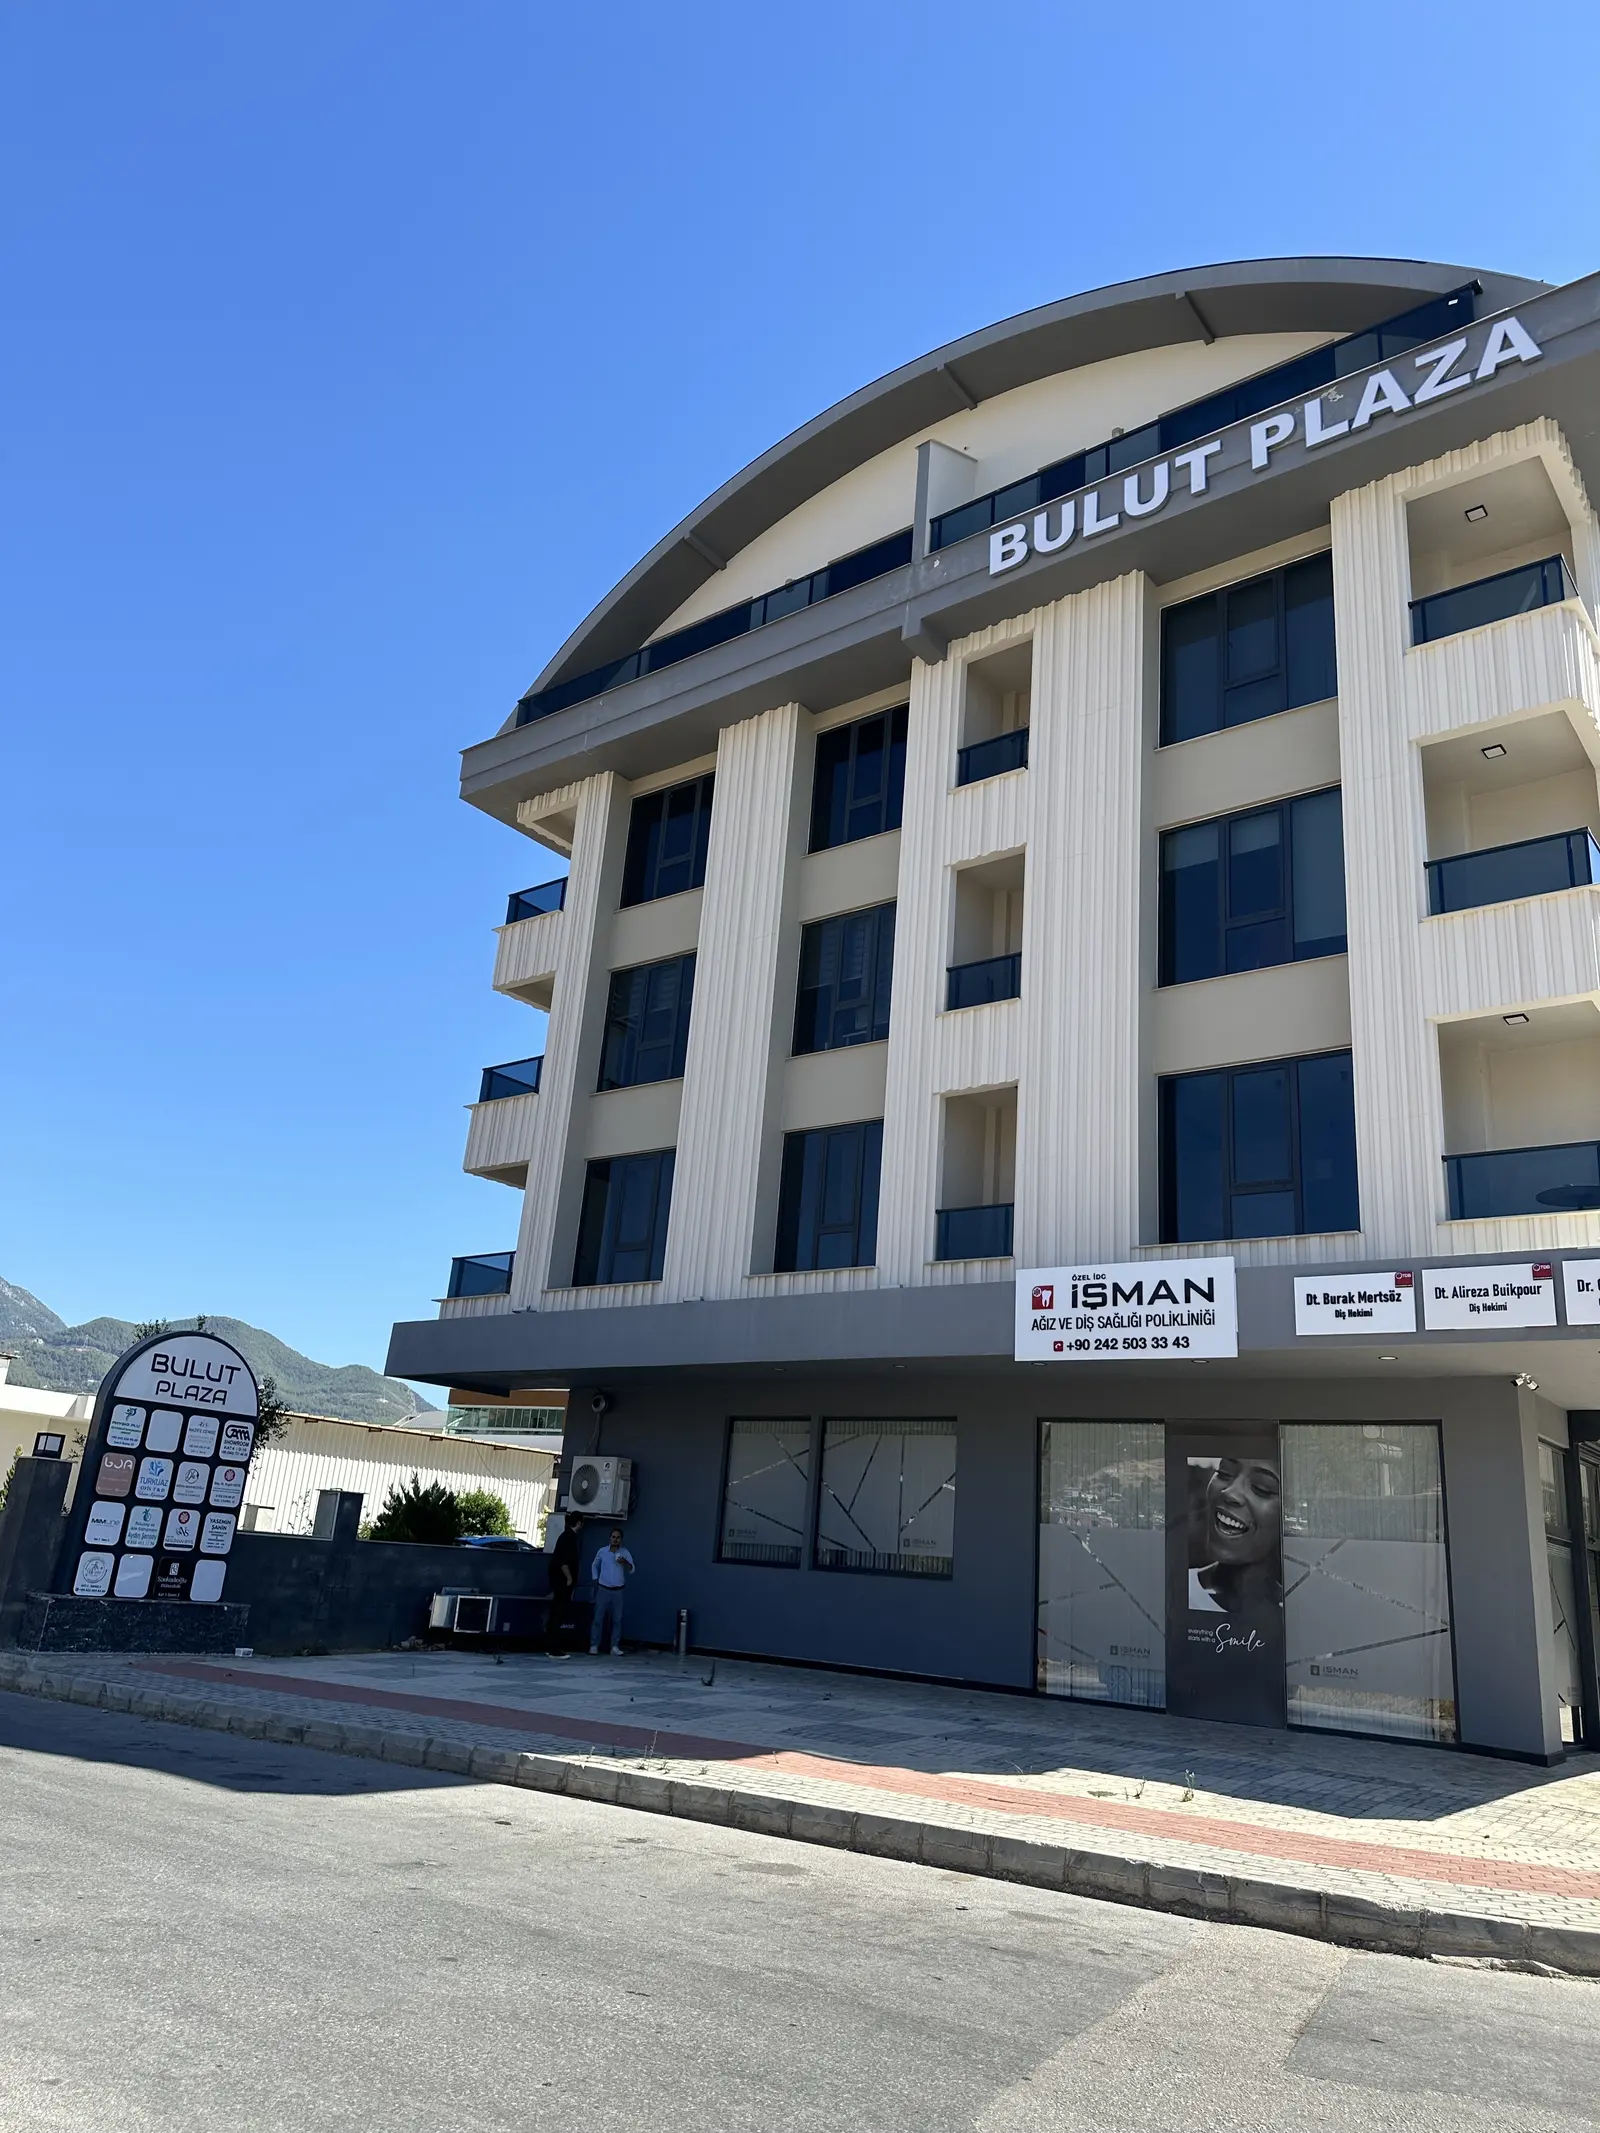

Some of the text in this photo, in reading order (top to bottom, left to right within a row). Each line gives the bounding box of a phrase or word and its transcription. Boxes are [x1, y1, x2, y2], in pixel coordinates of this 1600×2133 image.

[988, 316, 1544, 577] BULUT PLAZA
[1072, 1272, 1106, 1281] ÖZEL İDC
[1071, 1277, 1215, 1310] İŞMAN
[1434, 1283, 1542, 1300] Dt. Alireza Buikpour
[1577, 1279, 1594, 1292] Dr.
[1306, 1290, 1402, 1306] Dt. Burak Mertsöz
[1335, 1308, 1372, 1320] Diş Hekimi
[1469, 1302, 1507, 1314] Diş Hekimi
[1031, 1309, 1215, 1332] AĞIZ VE DİŞ SAĞLIĞI POLİKLİNİĞİ
[1066, 1336, 1190, 1351] +90 242 503 33 43
[151, 1353, 241, 1385] BULUT
[156, 1380, 228, 1406] PLAZA
[1188, 1628, 1214, 1636] everything
[1216, 1623, 1265, 1653] Smile
